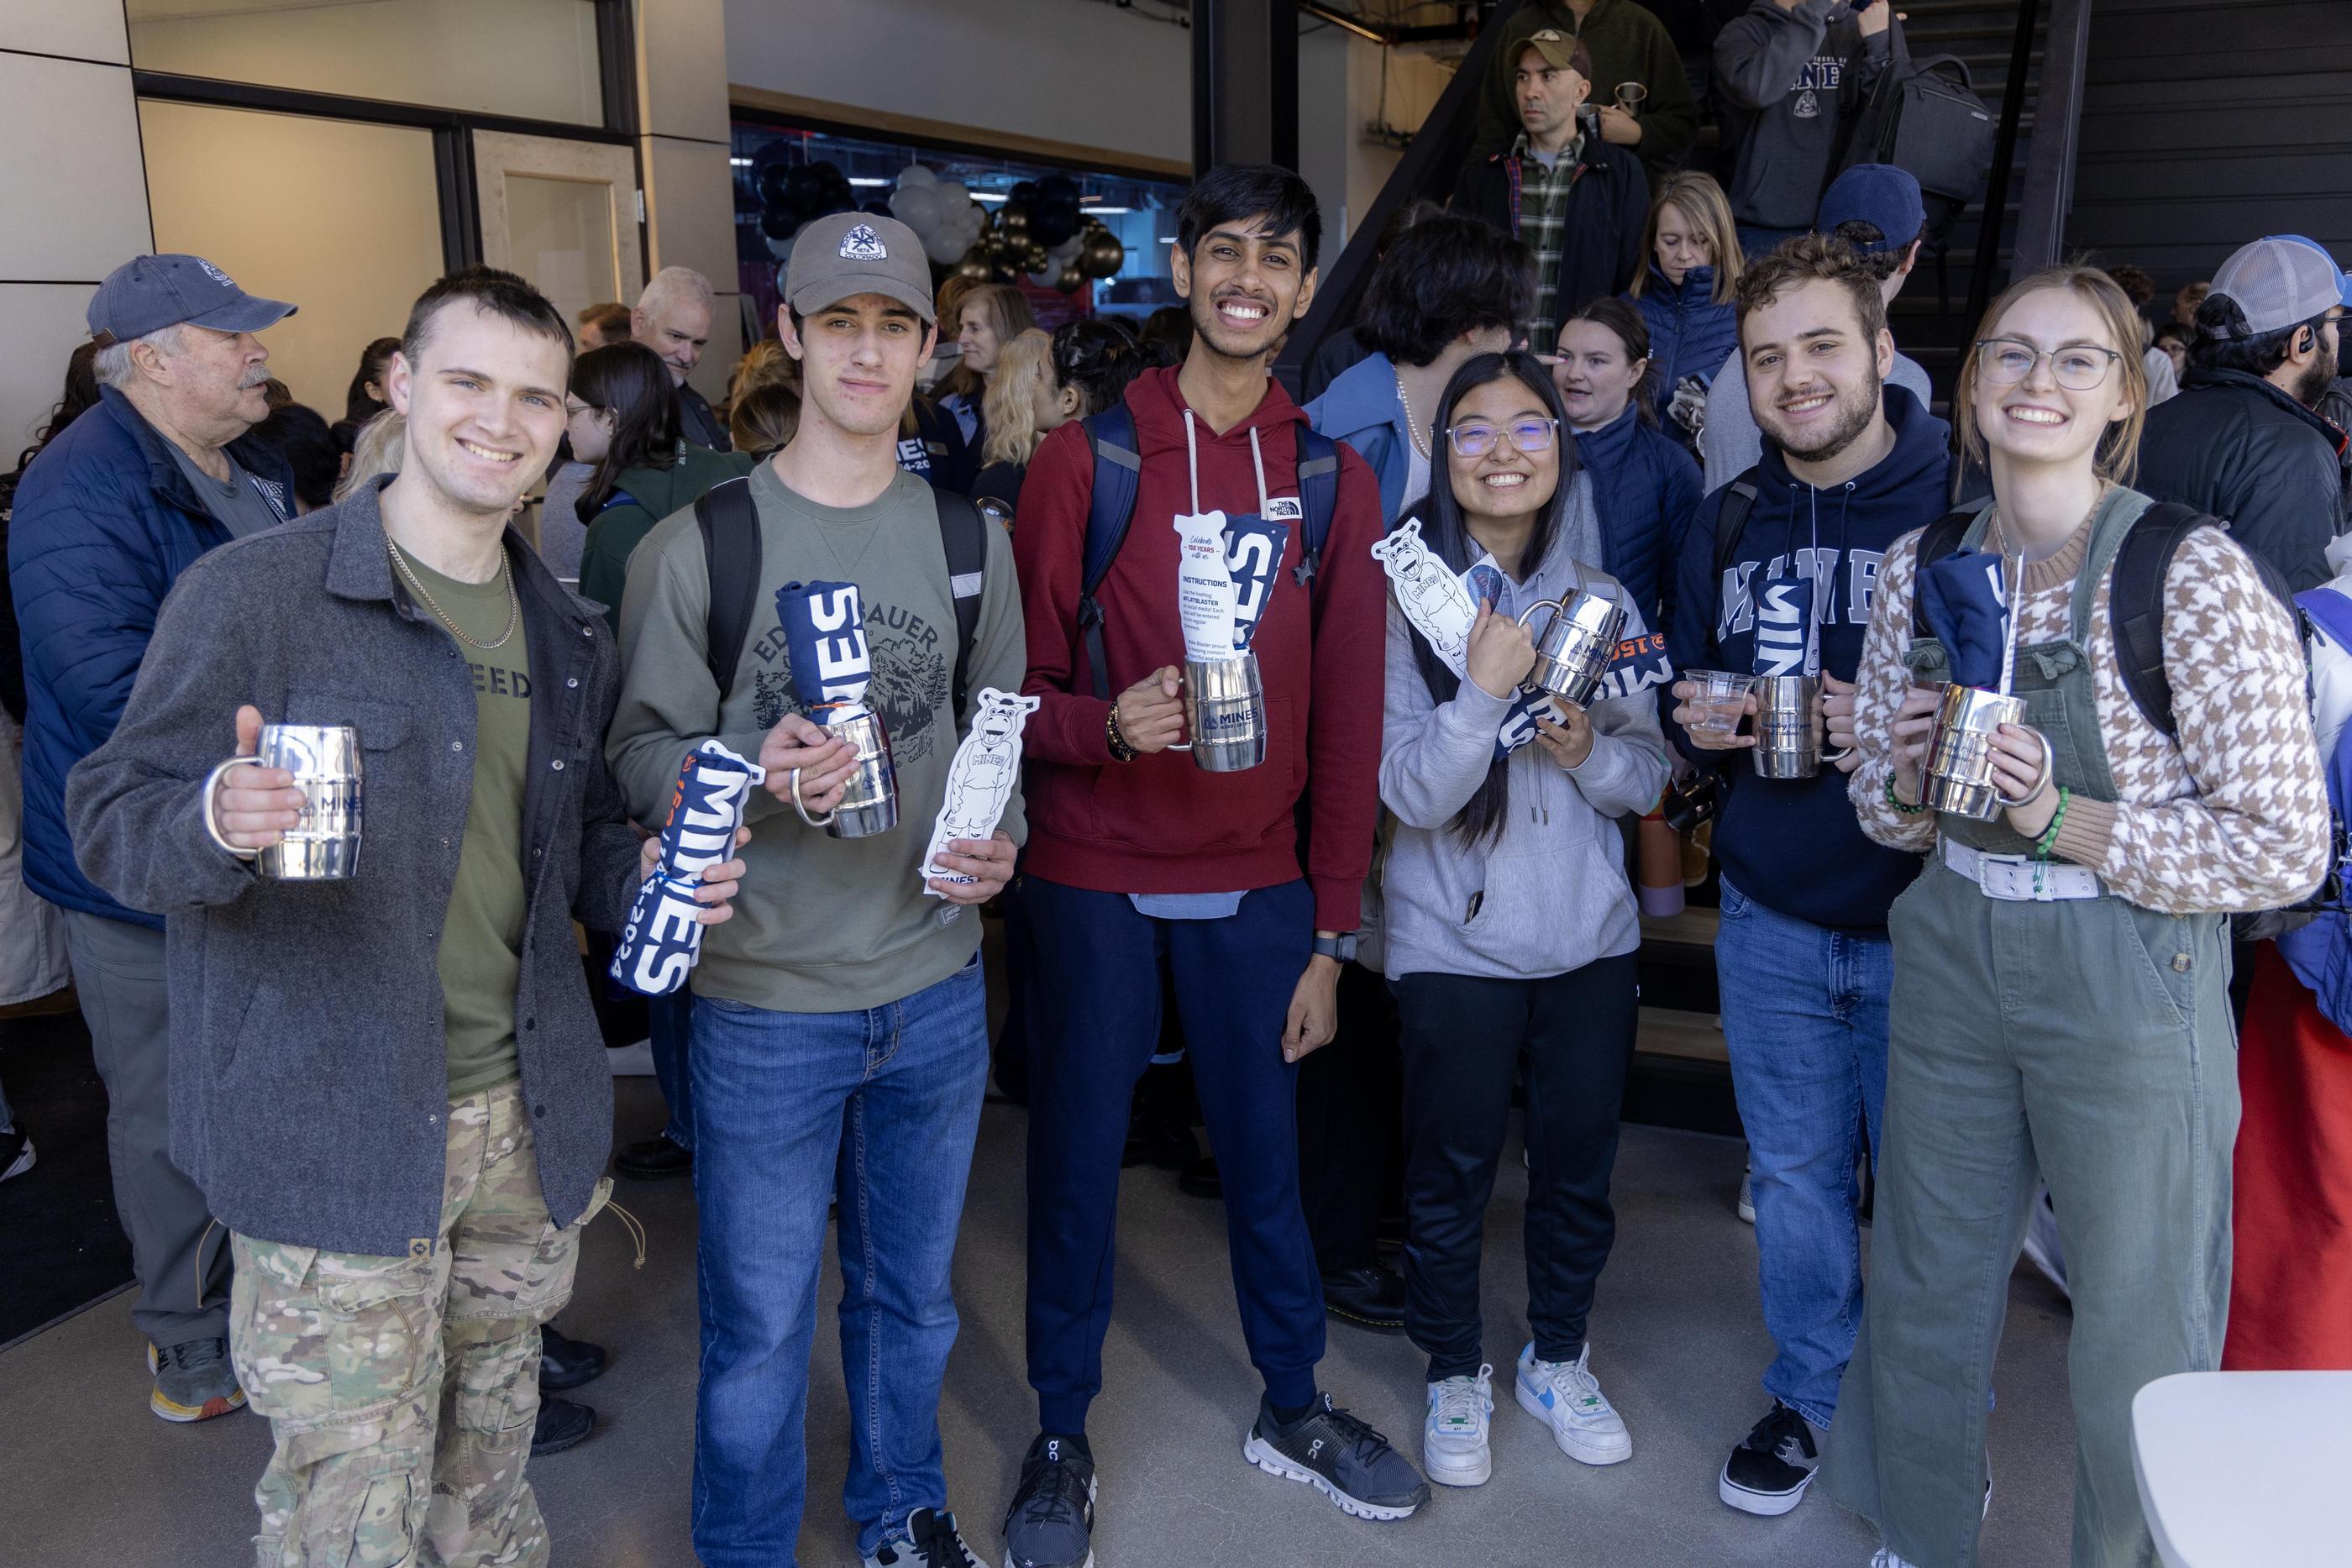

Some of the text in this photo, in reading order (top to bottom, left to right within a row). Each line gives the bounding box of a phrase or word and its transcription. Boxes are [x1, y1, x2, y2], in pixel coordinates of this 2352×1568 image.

[1183, 576, 1227, 588] INSTRUCTIONS
[1412, 574, 1439, 600] MINES
[1184, 596, 1219, 606] #FLATBLASTER
[1220, 708, 1257, 724] MINES
[973, 754, 1005, 766] MINES
